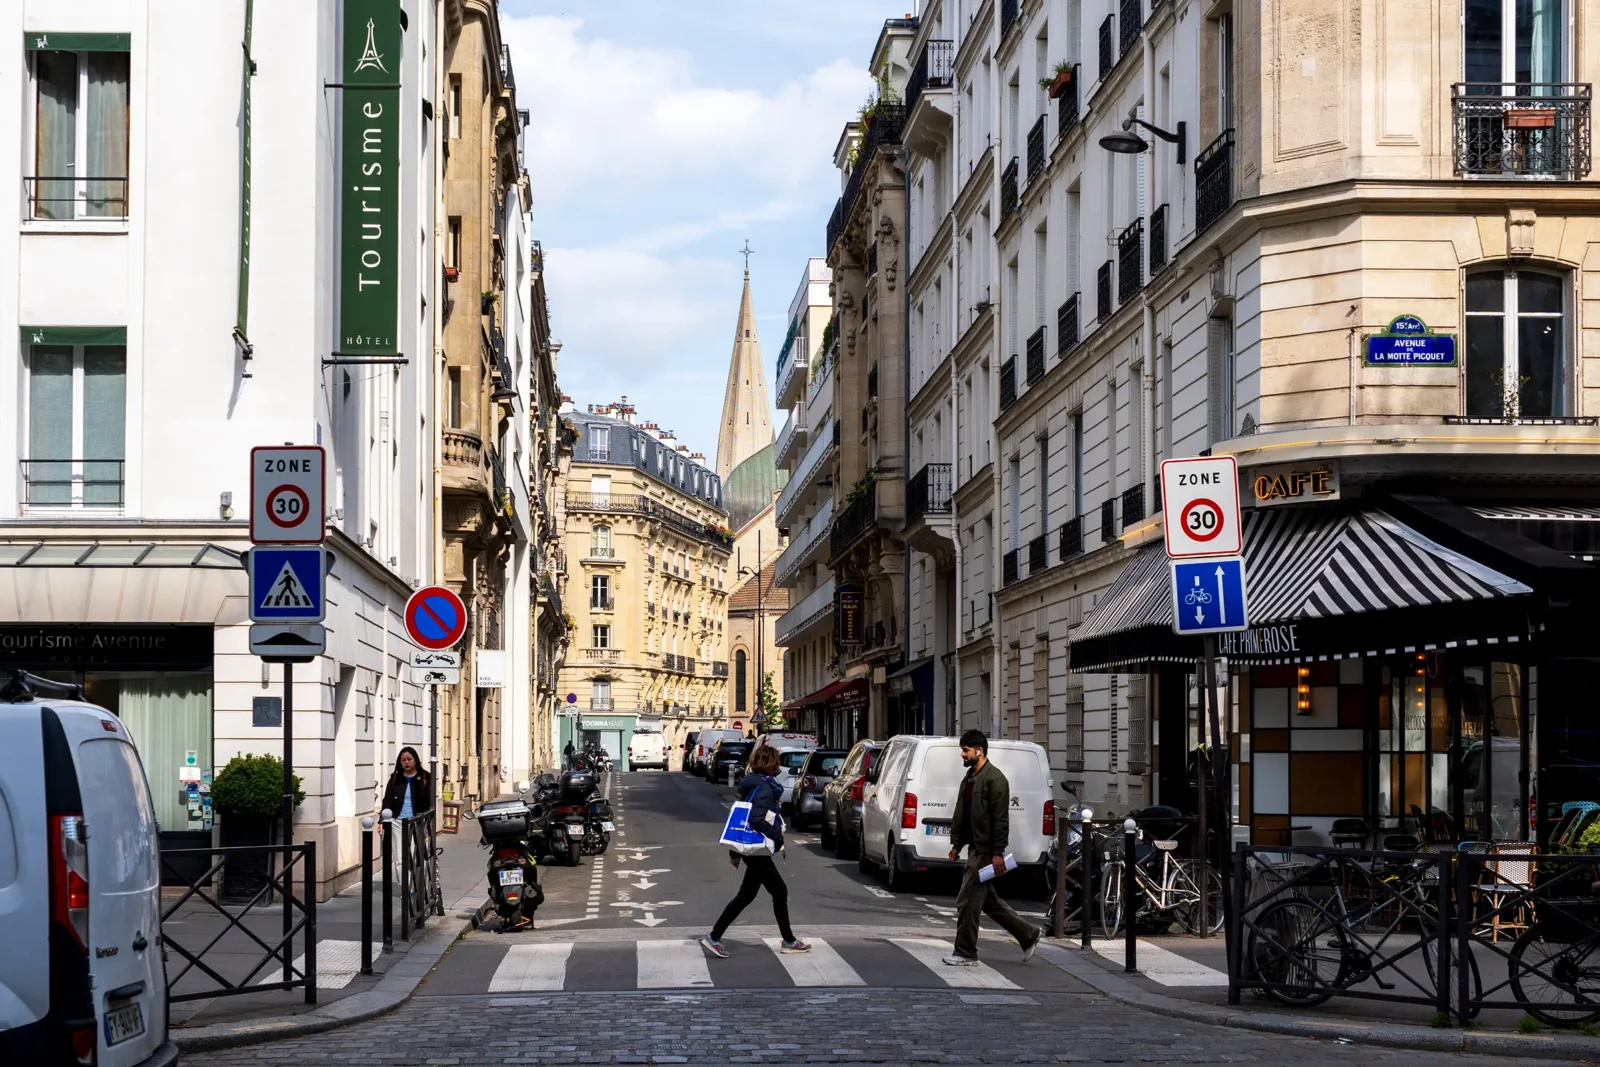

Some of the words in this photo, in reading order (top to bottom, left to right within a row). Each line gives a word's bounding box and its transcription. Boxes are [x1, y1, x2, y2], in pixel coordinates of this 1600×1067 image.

[353, 102, 383, 292] Tourisme
[347, 335, 391, 345] HÔTEL
[1394, 339, 1426, 347] AVENUE
[1375, 352, 1385, 360] LA
[1387, 352, 1411, 360] MOTTE
[1413, 352, 1445, 361] PICQUET
[264, 459, 312, 473] ZONE
[1178, 472, 1221, 486] ZONE
[1254, 465, 1335, 501] CAFÉ
[275, 498, 300, 514] 30
[1189, 510, 1216, 530] 30
[91, 633, 167, 649] Avenue
[1240, 625, 1300, 654] PRIMEROSE
[609, 720, 624, 728] HAIR
